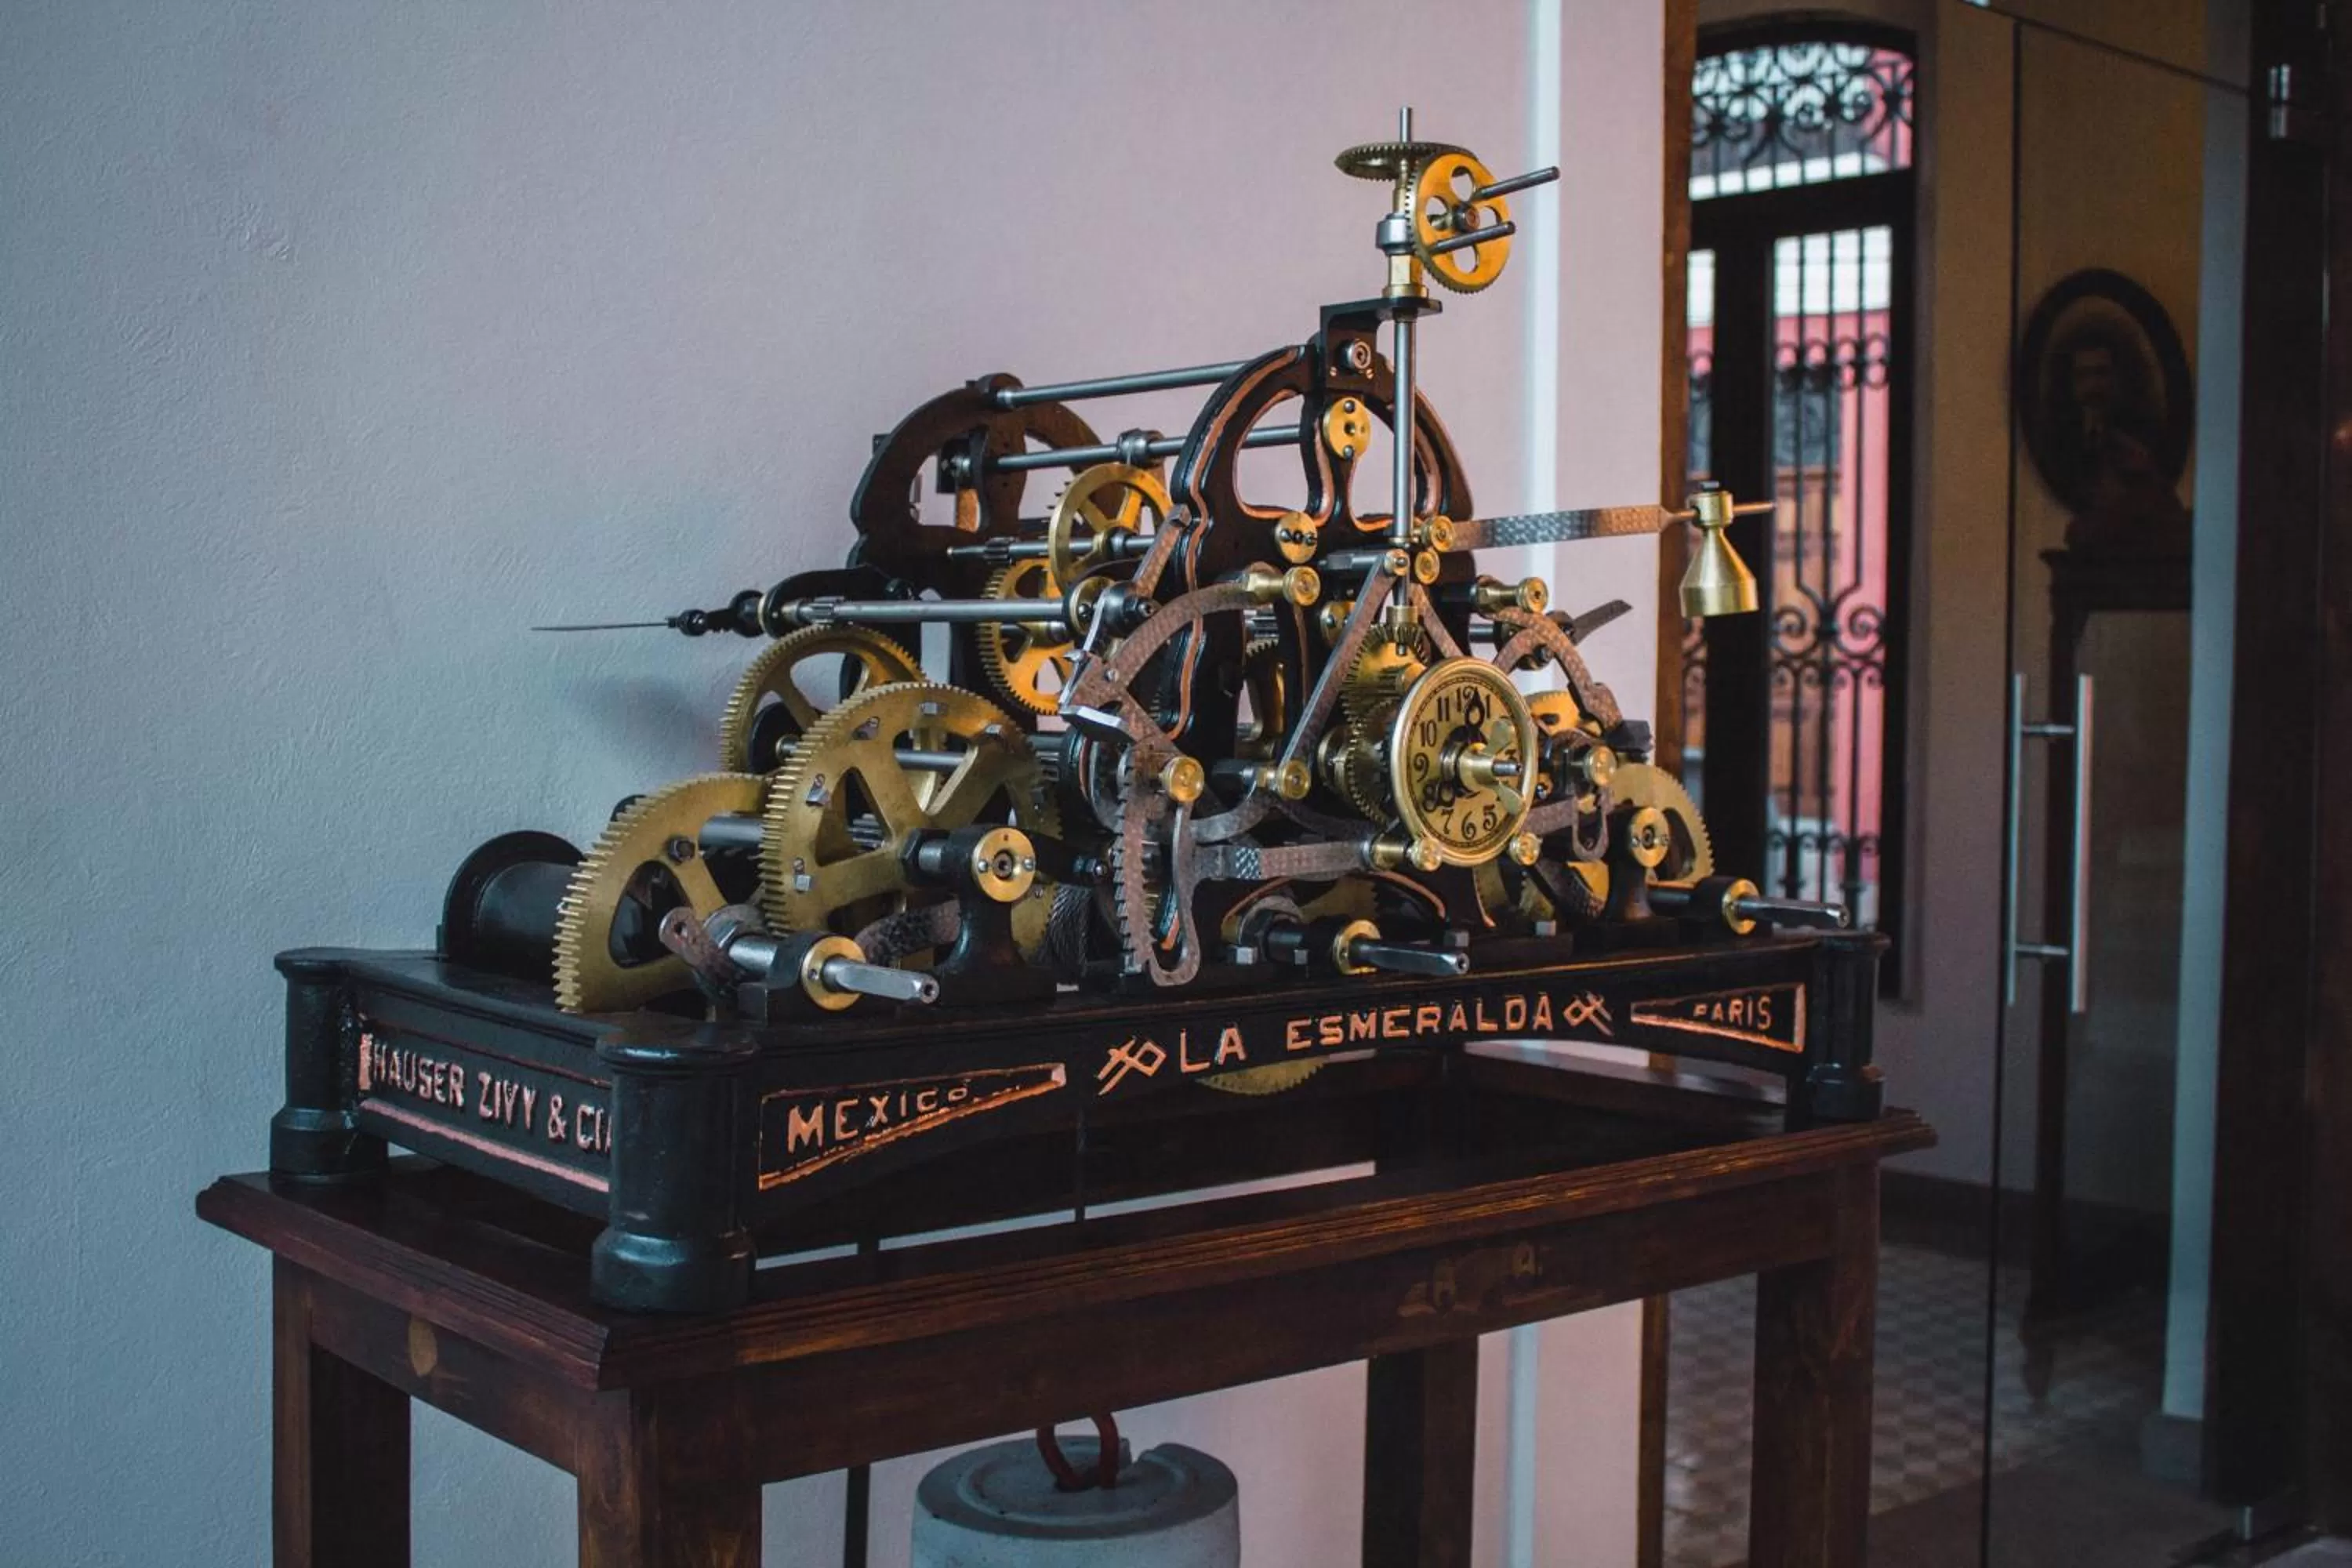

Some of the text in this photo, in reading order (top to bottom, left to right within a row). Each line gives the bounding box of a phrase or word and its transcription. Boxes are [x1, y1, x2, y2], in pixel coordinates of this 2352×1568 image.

[1436, 696, 1450, 722] 11
[1420, 720, 1438, 748] 10
[1414, 752, 1429, 782] 9
[1422, 782, 1438, 813] 8
[1441, 809, 1454, 834] 7
[1461, 811, 1476, 840] 6
[1483, 804, 1497, 831] 5
[1693, 995, 1772, 1030] PARIS
[1179, 993, 1554, 1073] LA ESMERALDA
[373, 1041, 612, 1152] HAUSER ZIVY & CI
